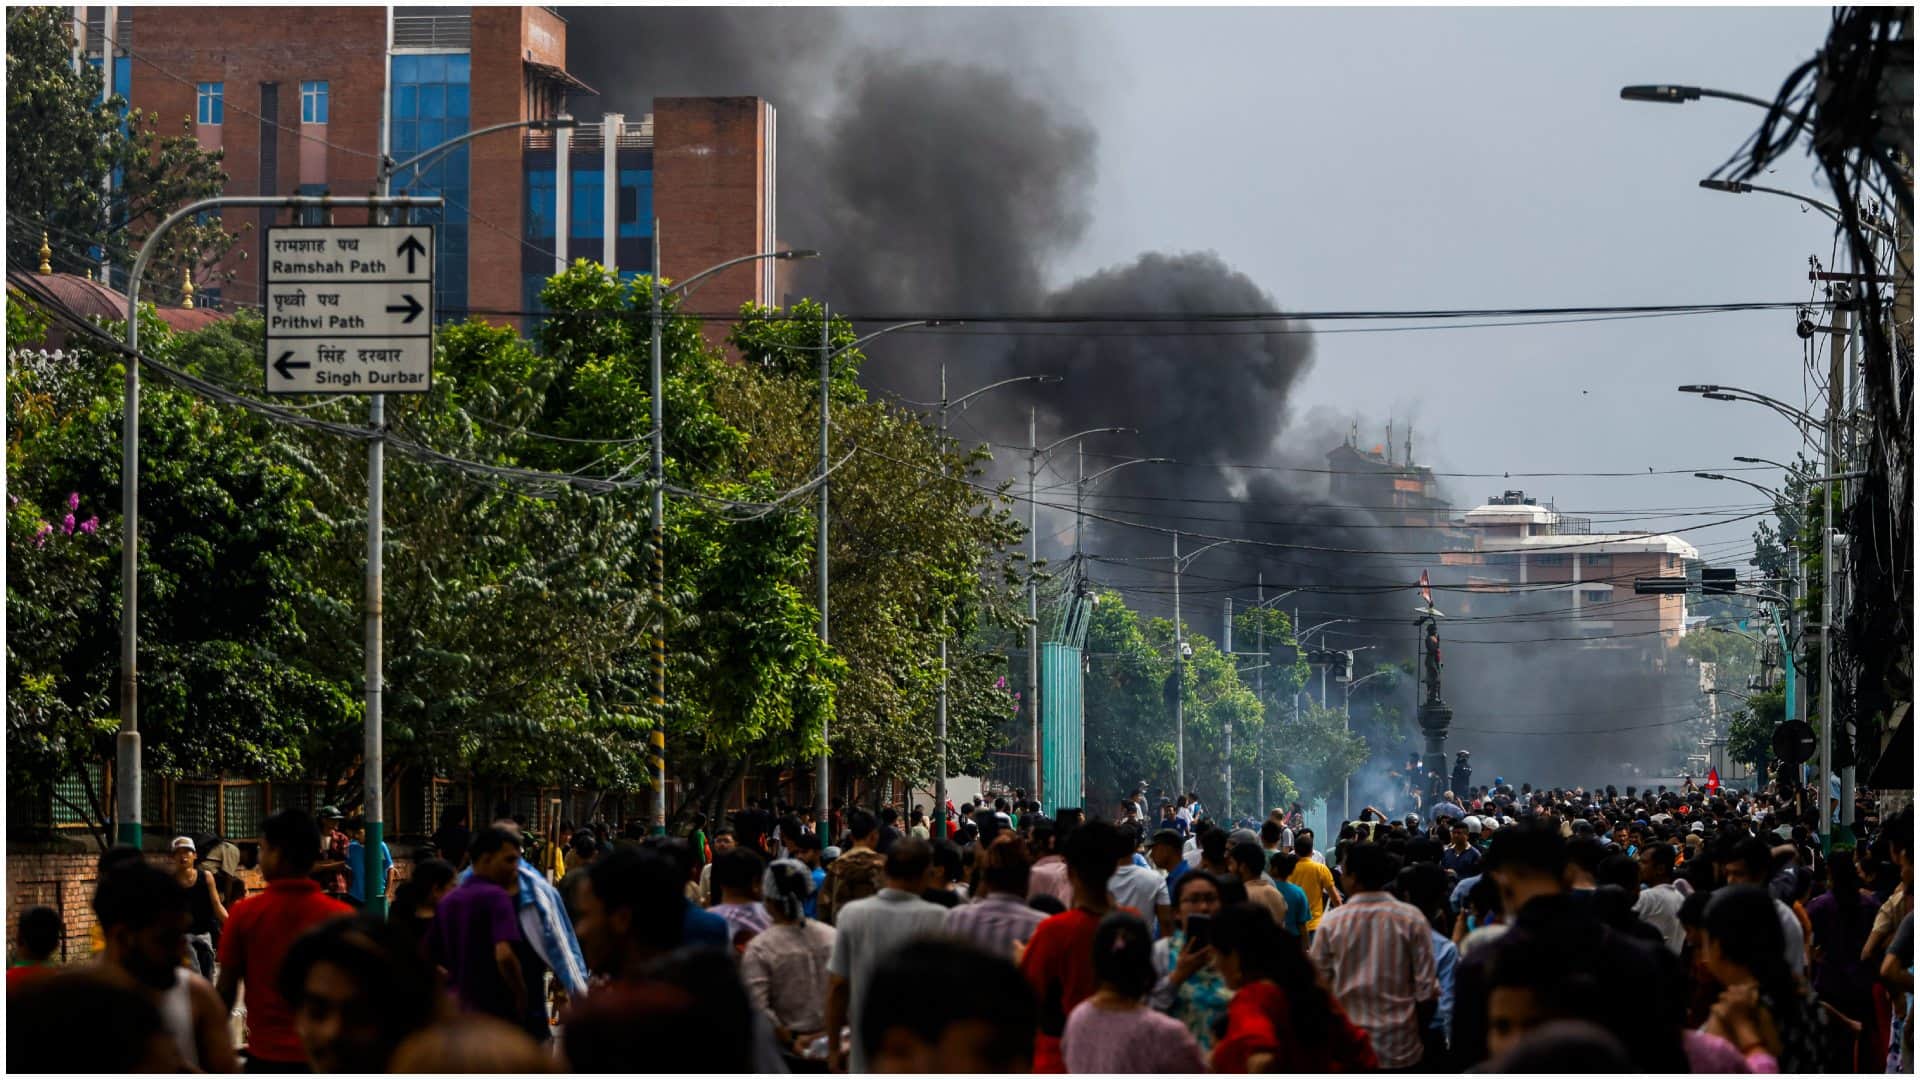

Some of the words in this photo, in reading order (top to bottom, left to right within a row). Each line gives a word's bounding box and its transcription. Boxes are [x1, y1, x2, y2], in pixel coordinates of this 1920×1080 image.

[336, 238, 360, 252] पथ
[272, 260, 344, 274] Ramshah
[350, 260, 386, 273] Path
[317, 294, 340, 307] पथ
[272, 315, 322, 329] Prithvi
[329, 315, 364, 328] Path
[357, 349, 404, 364] दरबार
[315, 371, 361, 386] Singh
[368, 370, 424, 384] Durbar
